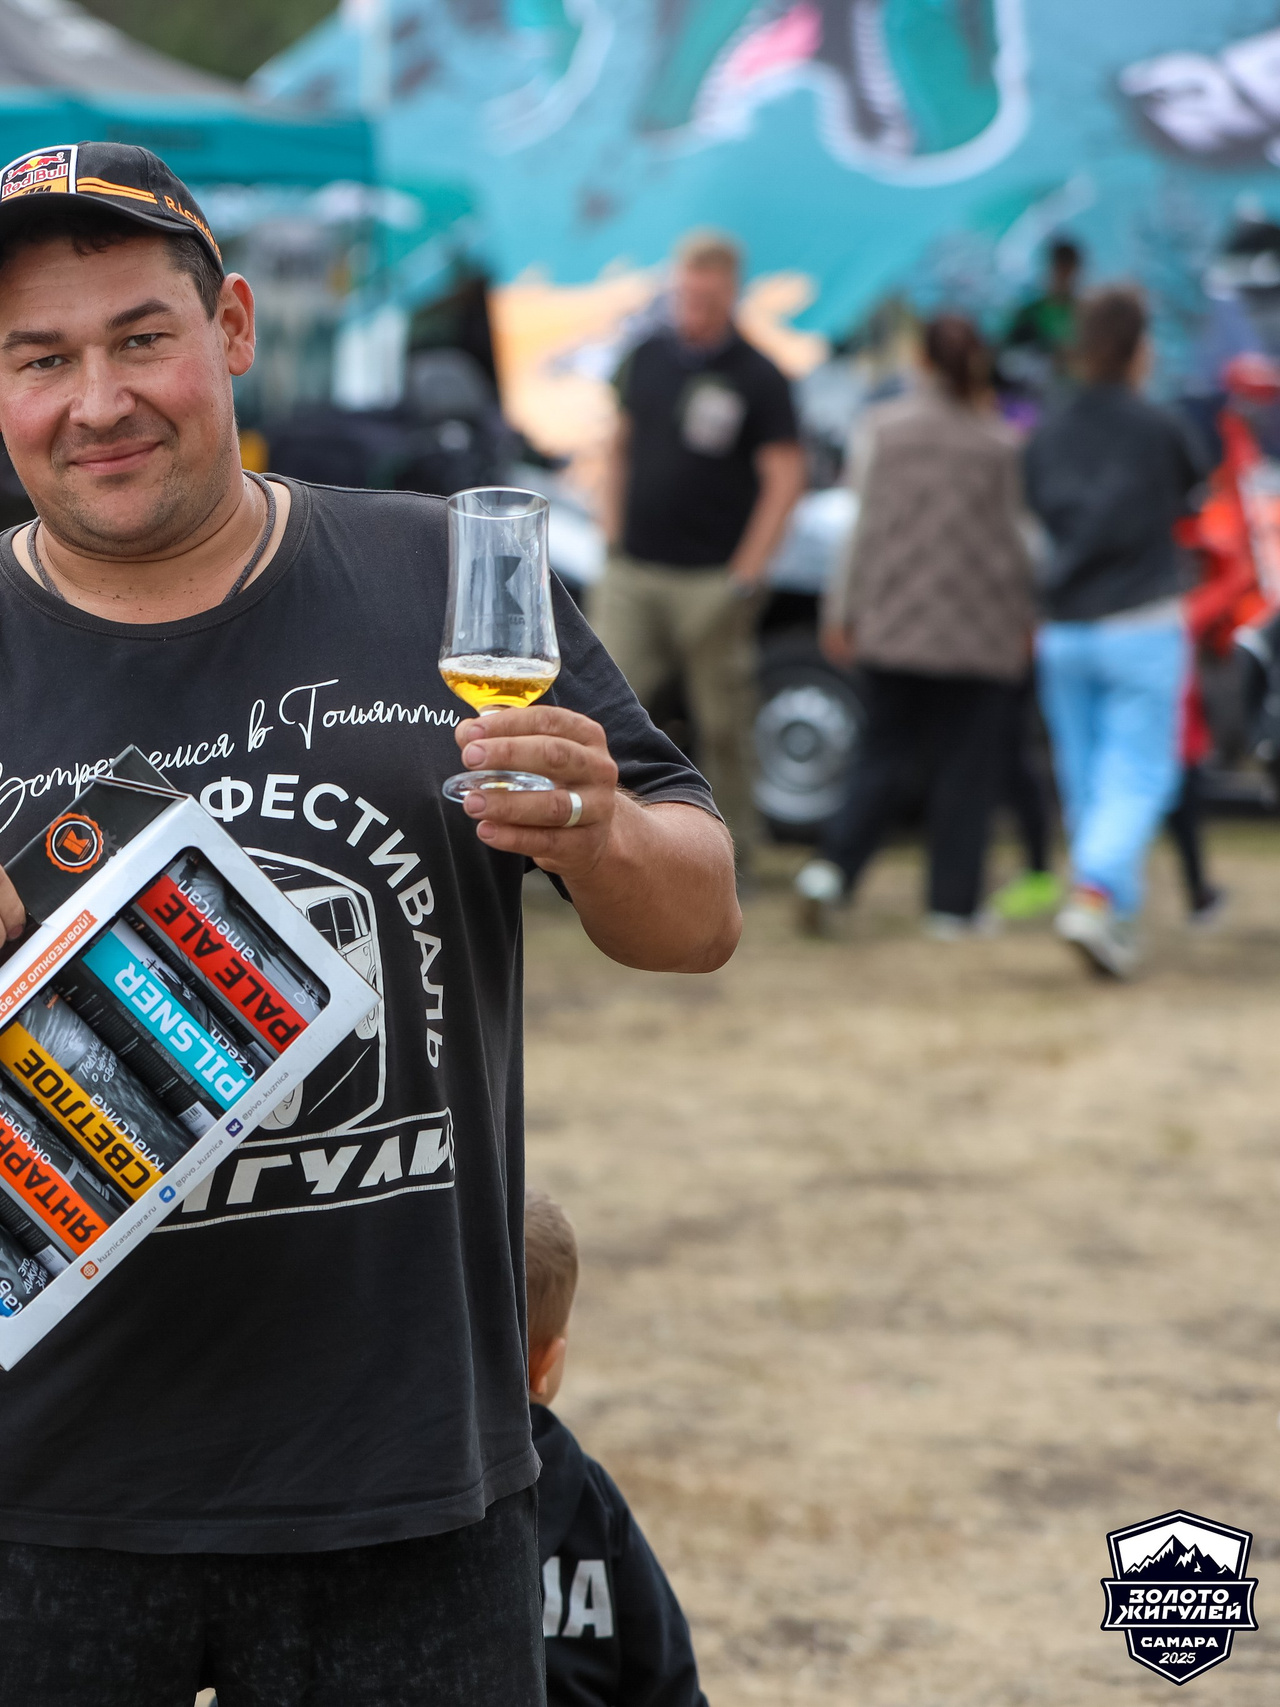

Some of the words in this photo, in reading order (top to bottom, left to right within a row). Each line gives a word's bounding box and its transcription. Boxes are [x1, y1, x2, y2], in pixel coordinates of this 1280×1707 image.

[2, 172, 33, 198] Red
[35, 164, 68, 183] Bull
[248, 699, 273, 753] в
[12, 980, 28, 998] не
[25, 913, 91, 983] отказывай!
[153, 892, 224, 959] ALE
[177, 879, 255, 962] american
[200, 773, 446, 1070] ФЕСТИВАЛЬ
[113, 961, 246, 1101] PILSNER
[214, 958, 301, 1046] PALE
[210, 1025, 256, 1080] Czech
[12, 1048, 150, 1189] СВЕТЛОЕ
[88, 1092, 165, 1173] классика
[241, 1071, 290, 1121] @pivo_kuznica
[174, 1138, 225, 1189] @pivo_kuznica
[96, 1205, 158, 1264] kuznicasamara.ru
